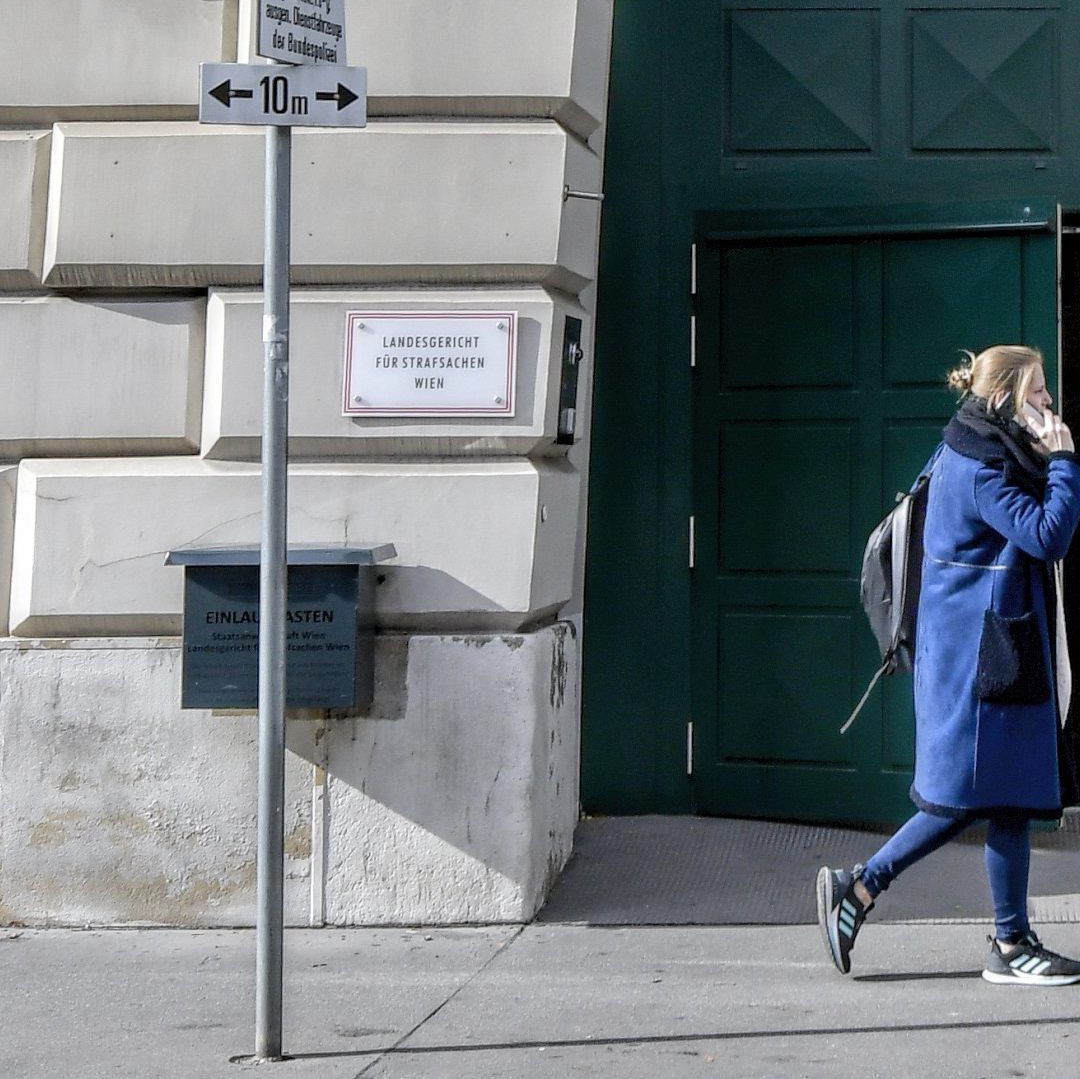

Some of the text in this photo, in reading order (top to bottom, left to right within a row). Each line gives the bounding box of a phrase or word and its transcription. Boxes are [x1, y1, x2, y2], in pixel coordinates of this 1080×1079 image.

[272, 28, 338, 64] der Bundespolizei
[382, 336, 480, 349] LANDESGERICHT
[375, 355, 485, 369] FÜR STRAFSACHEN
[414, 377, 445, 390] WIEN
